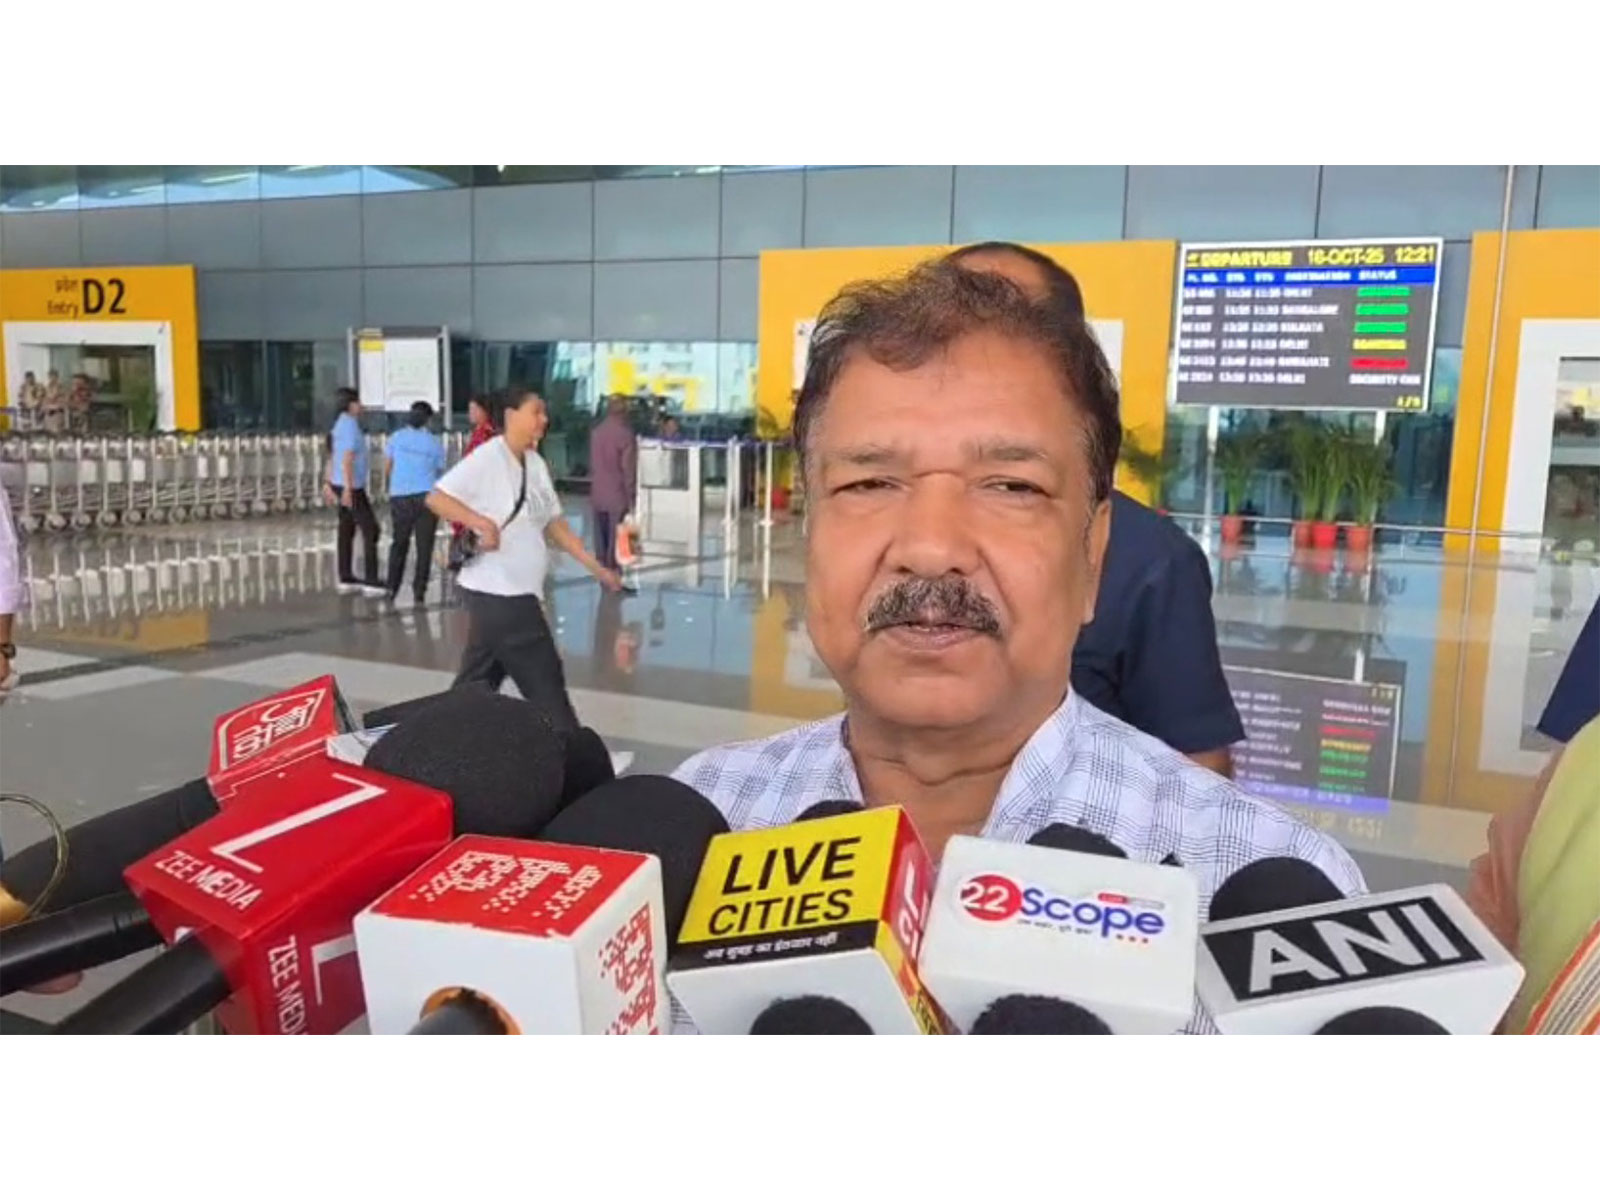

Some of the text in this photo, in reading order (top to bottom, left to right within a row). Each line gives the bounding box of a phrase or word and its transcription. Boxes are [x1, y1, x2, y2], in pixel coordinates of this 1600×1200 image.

[1395, 245, 1435, 263] 12:21
[47, 300, 79, 319] Entry
[82, 278, 126, 315] D2
[154, 850, 263, 911] ZEE MEDIA
[721, 836, 861, 896] LIVE
[708, 888, 854, 936] CITIES
[268, 934, 299, 989] ZEE
[1249, 902, 1462, 993] ANI
